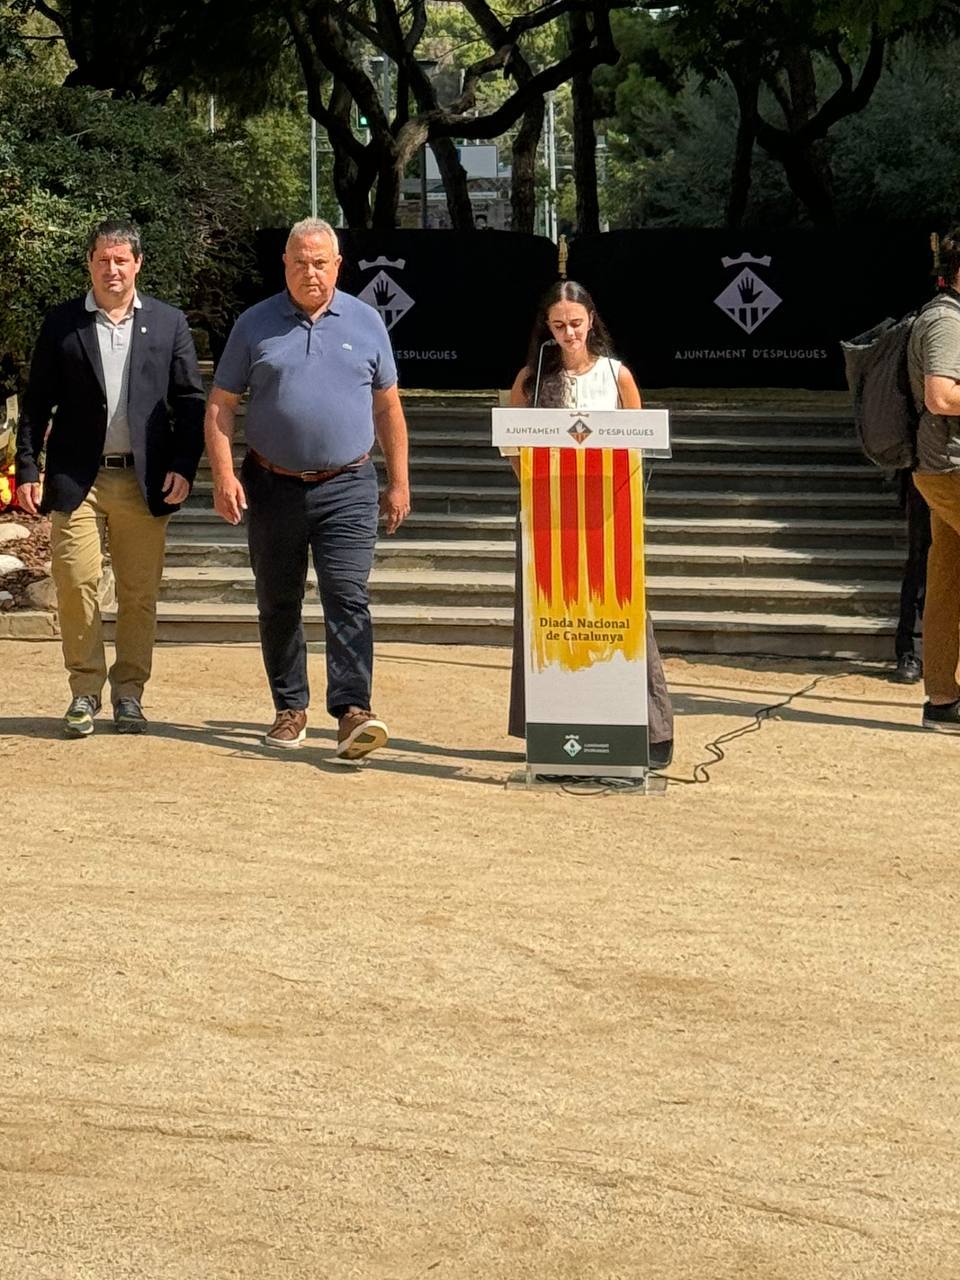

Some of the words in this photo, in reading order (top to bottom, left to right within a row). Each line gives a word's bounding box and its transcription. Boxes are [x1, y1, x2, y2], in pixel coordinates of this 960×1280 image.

[396, 350, 458, 360] ESPLUGUES
[674, 349, 747, 360] AJUNTAMENT
[752, 349, 828, 359] D'ESPLUGUES
[506, 427, 560, 435] AJUNTAMENT
[598, 429, 654, 437] D'ESPLUGUES
[540, 617, 573, 628] Diada
[577, 618, 630, 629] Nacional
[546, 631, 560, 641] de
[563, 631, 624, 644] Catalunya
